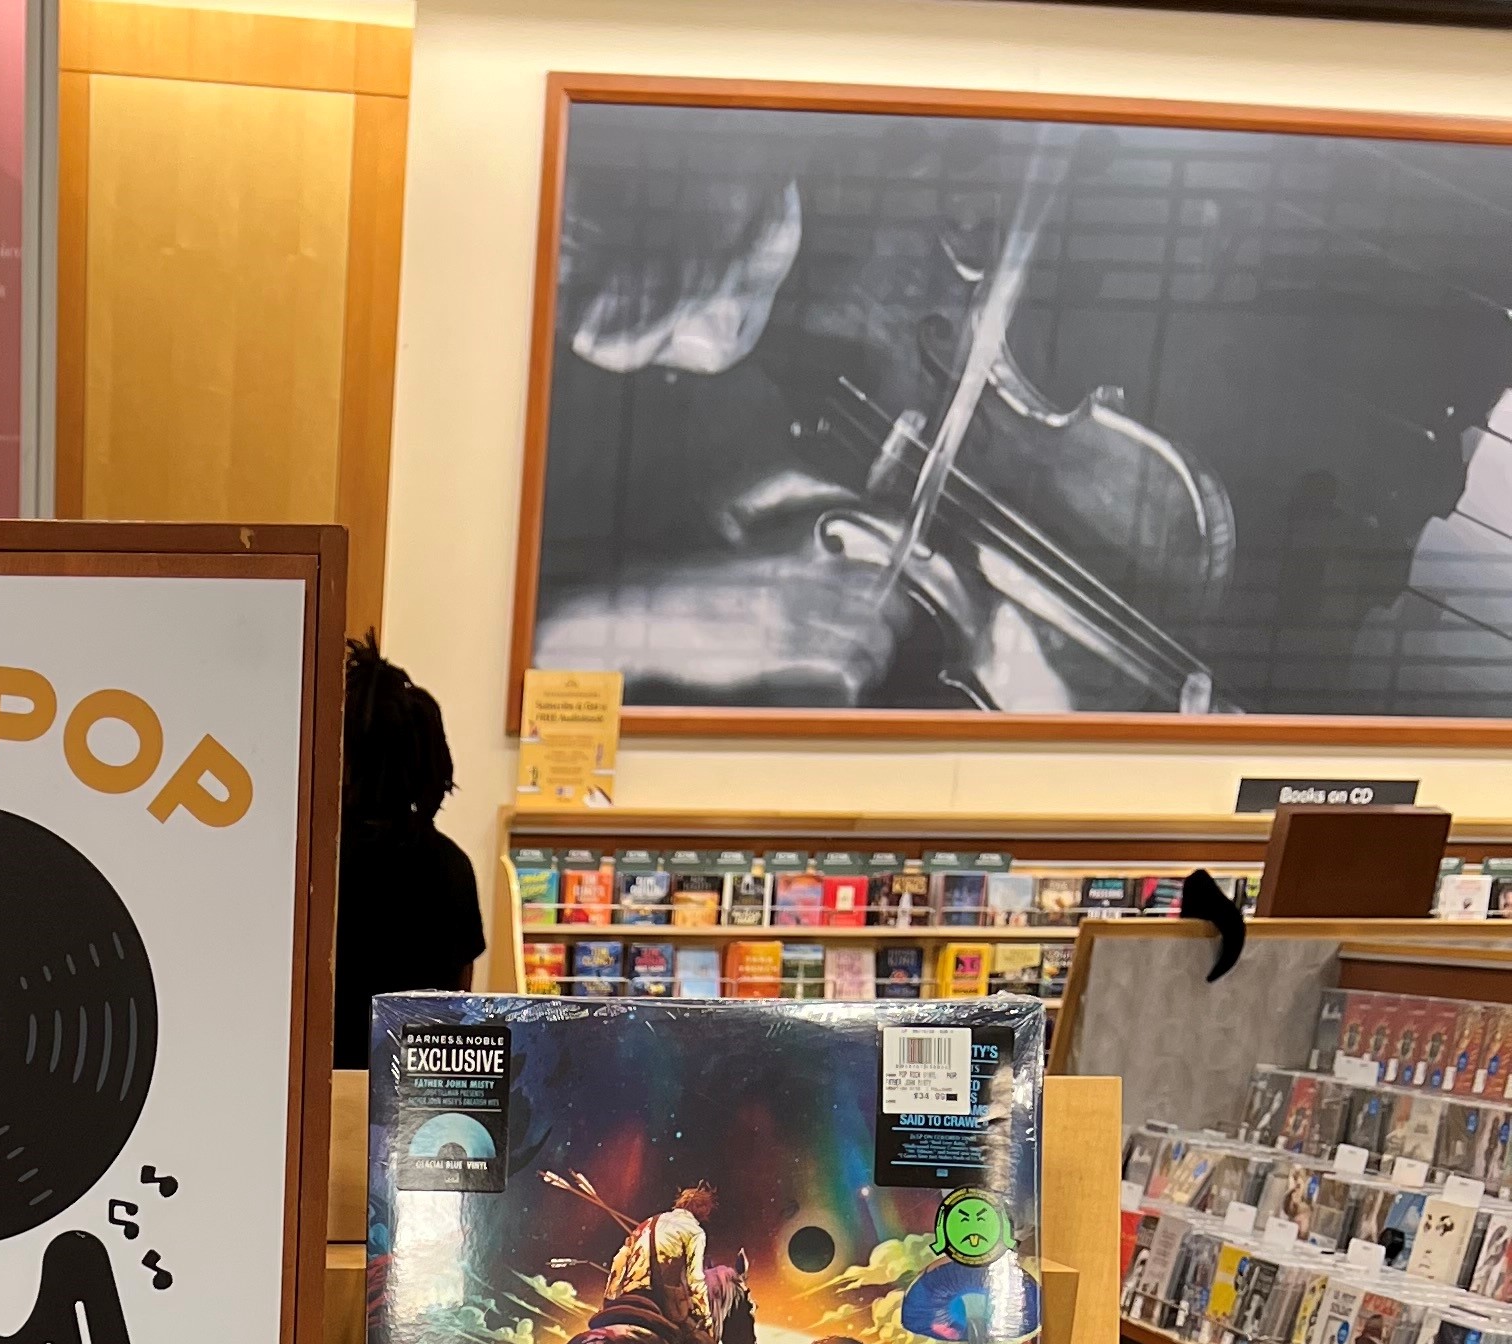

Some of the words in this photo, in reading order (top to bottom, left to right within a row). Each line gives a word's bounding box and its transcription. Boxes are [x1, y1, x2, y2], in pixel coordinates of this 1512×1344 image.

[1278, 786, 1327, 804] Books
[1349, 785, 1375, 804] CD
[406, 1034, 454, 1045] BARNES
[465, 1036, 505, 1046] NOBLE
[406, 1047, 505, 1073] EXCLUSIVE
[445, 1079, 468, 1089] JOHN
[469, 1080, 495, 1090] MISTY
[899, 1114, 926, 1126] SAID
[927, 1115, 943, 1126] TO
